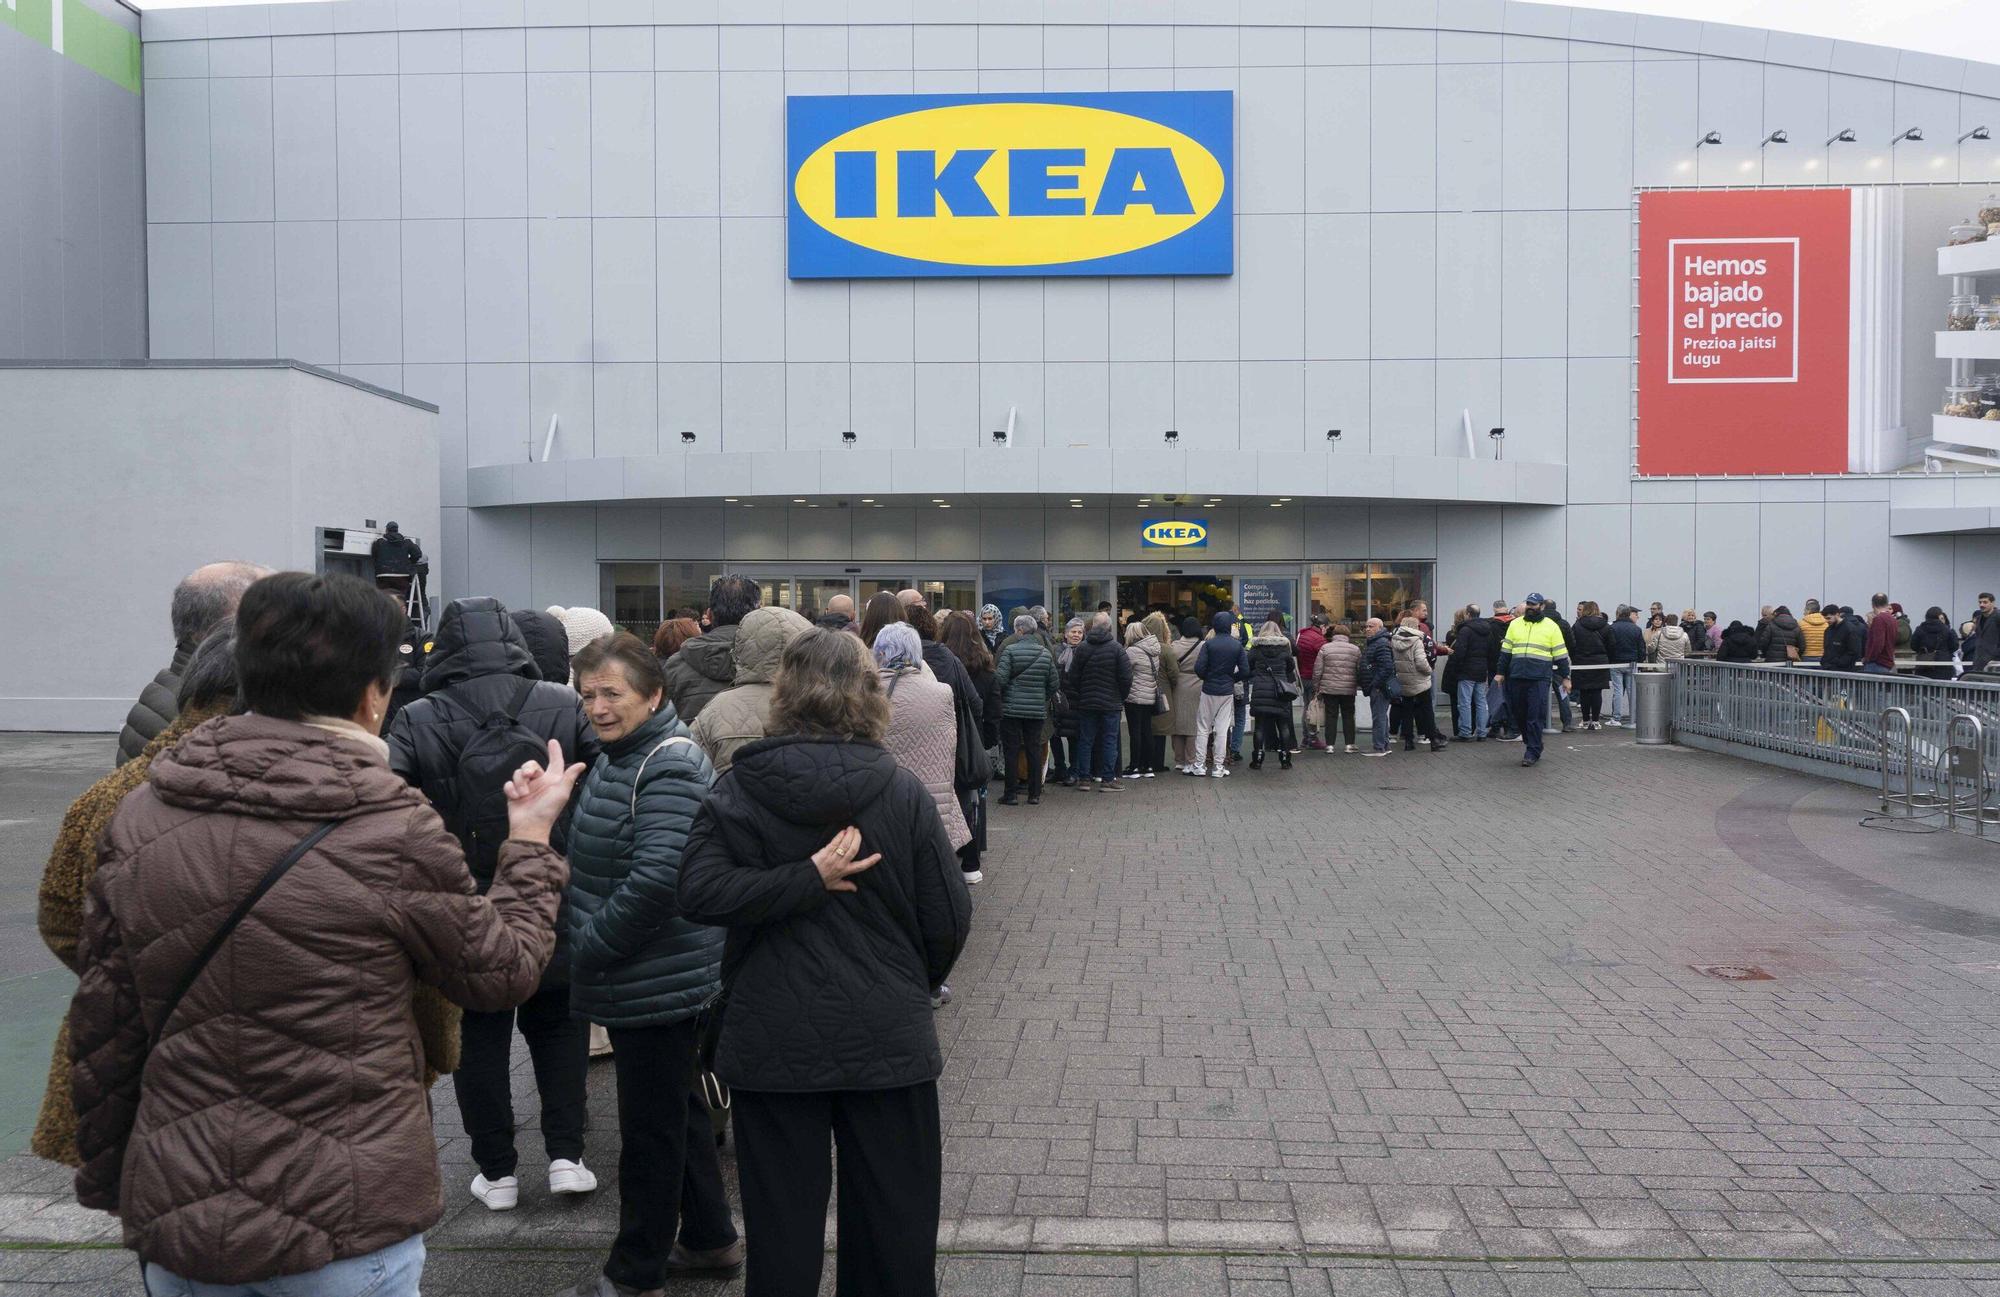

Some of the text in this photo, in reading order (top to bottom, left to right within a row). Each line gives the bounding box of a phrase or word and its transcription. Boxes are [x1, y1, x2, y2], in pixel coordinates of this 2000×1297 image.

[834, 147, 1197, 219] IKEA
[1684, 255, 1767, 276] Hemos
[1684, 280, 1764, 308] bajado
[1683, 306, 1783, 335] el precio
[1683, 335, 1777, 352] Prezioa jaitsi
[1682, 352, 1721, 368] dugu
[1149, 527, 1202, 539] IKEA
